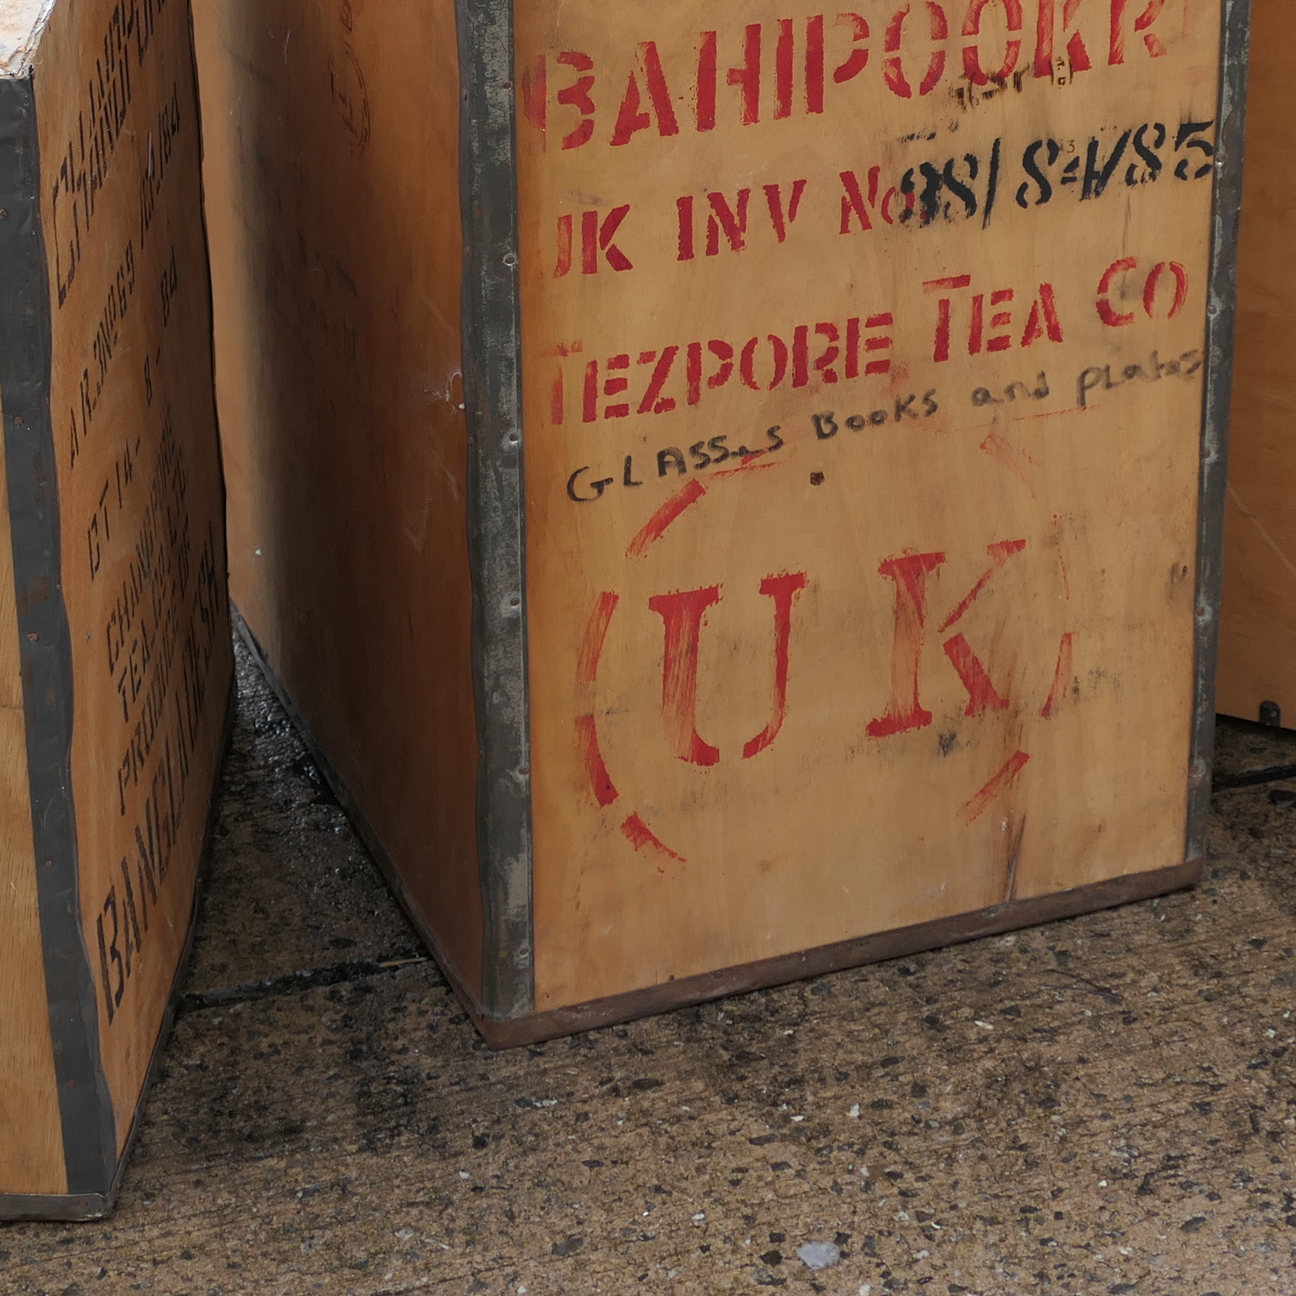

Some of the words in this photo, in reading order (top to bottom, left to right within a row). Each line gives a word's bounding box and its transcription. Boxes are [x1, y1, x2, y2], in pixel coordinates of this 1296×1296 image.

[676, 179, 808, 261] INV
[551, 312, 894, 426] TEZPORE
[922, 274, 1064, 363] TEA
[1095, 256, 1189, 328] CO
[648, 538, 1027, 768] UK
